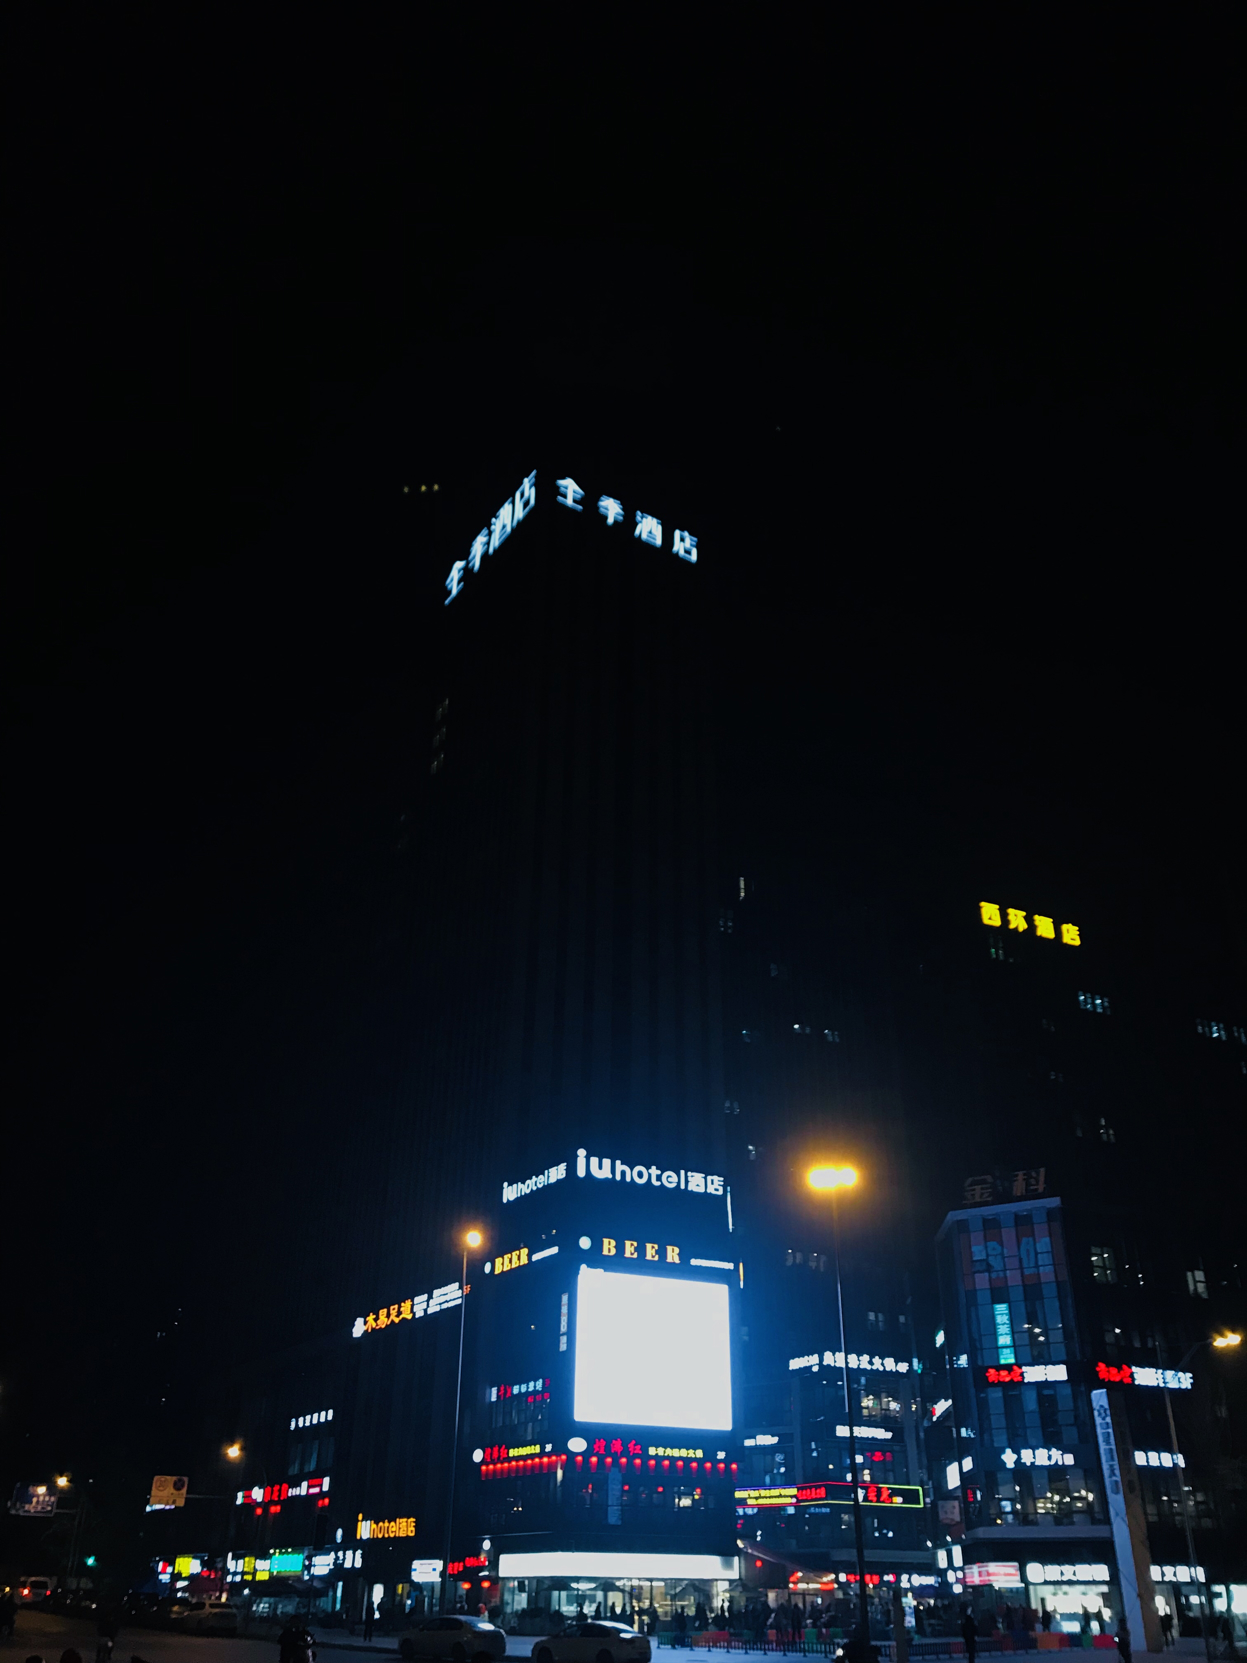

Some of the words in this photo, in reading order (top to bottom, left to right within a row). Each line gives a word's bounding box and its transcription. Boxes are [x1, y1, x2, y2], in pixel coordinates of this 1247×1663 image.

[444, 469, 537, 606] 全季酒店
[555, 477, 698, 564] 全季酒店
[979, 901, 1081, 947] 西环酒店
[962, 1167, 1047, 1204] 金科
[494, 1247, 529, 1275] BEER
[602, 1237, 681, 1264] BEER
[364, 1299, 413, 1332] 木易足道
